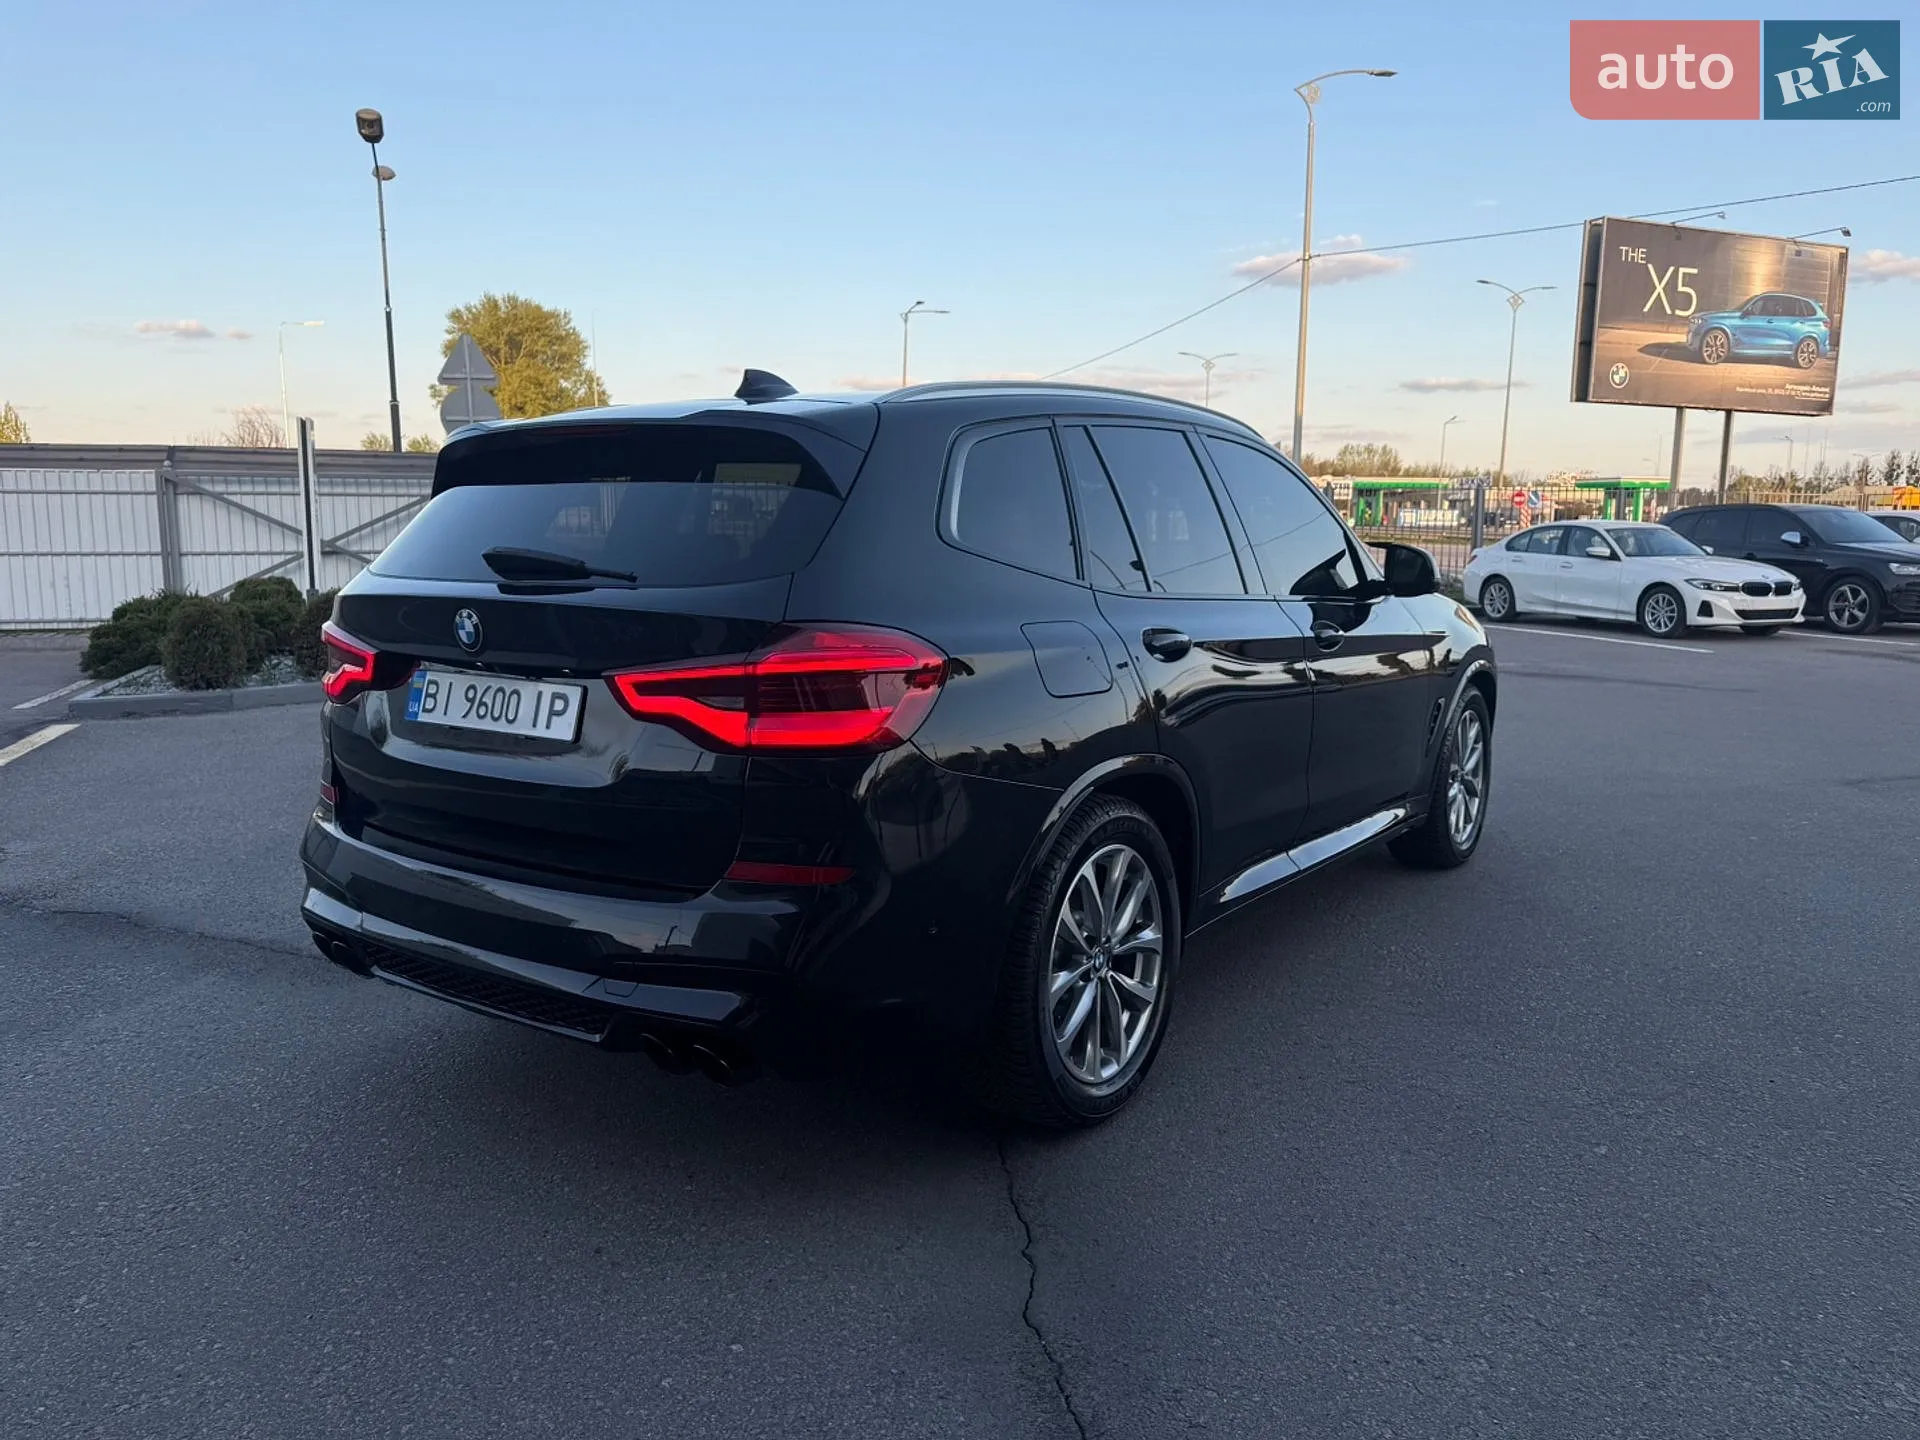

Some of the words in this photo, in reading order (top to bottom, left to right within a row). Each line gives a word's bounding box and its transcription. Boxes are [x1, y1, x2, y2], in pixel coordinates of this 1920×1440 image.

[1619, 246, 1647, 264] THE
[1642, 263, 1698, 317] X5
[421, 679, 453, 717] BI
[461, 683, 522, 725] 9600
[532, 690, 570, 730] IP
